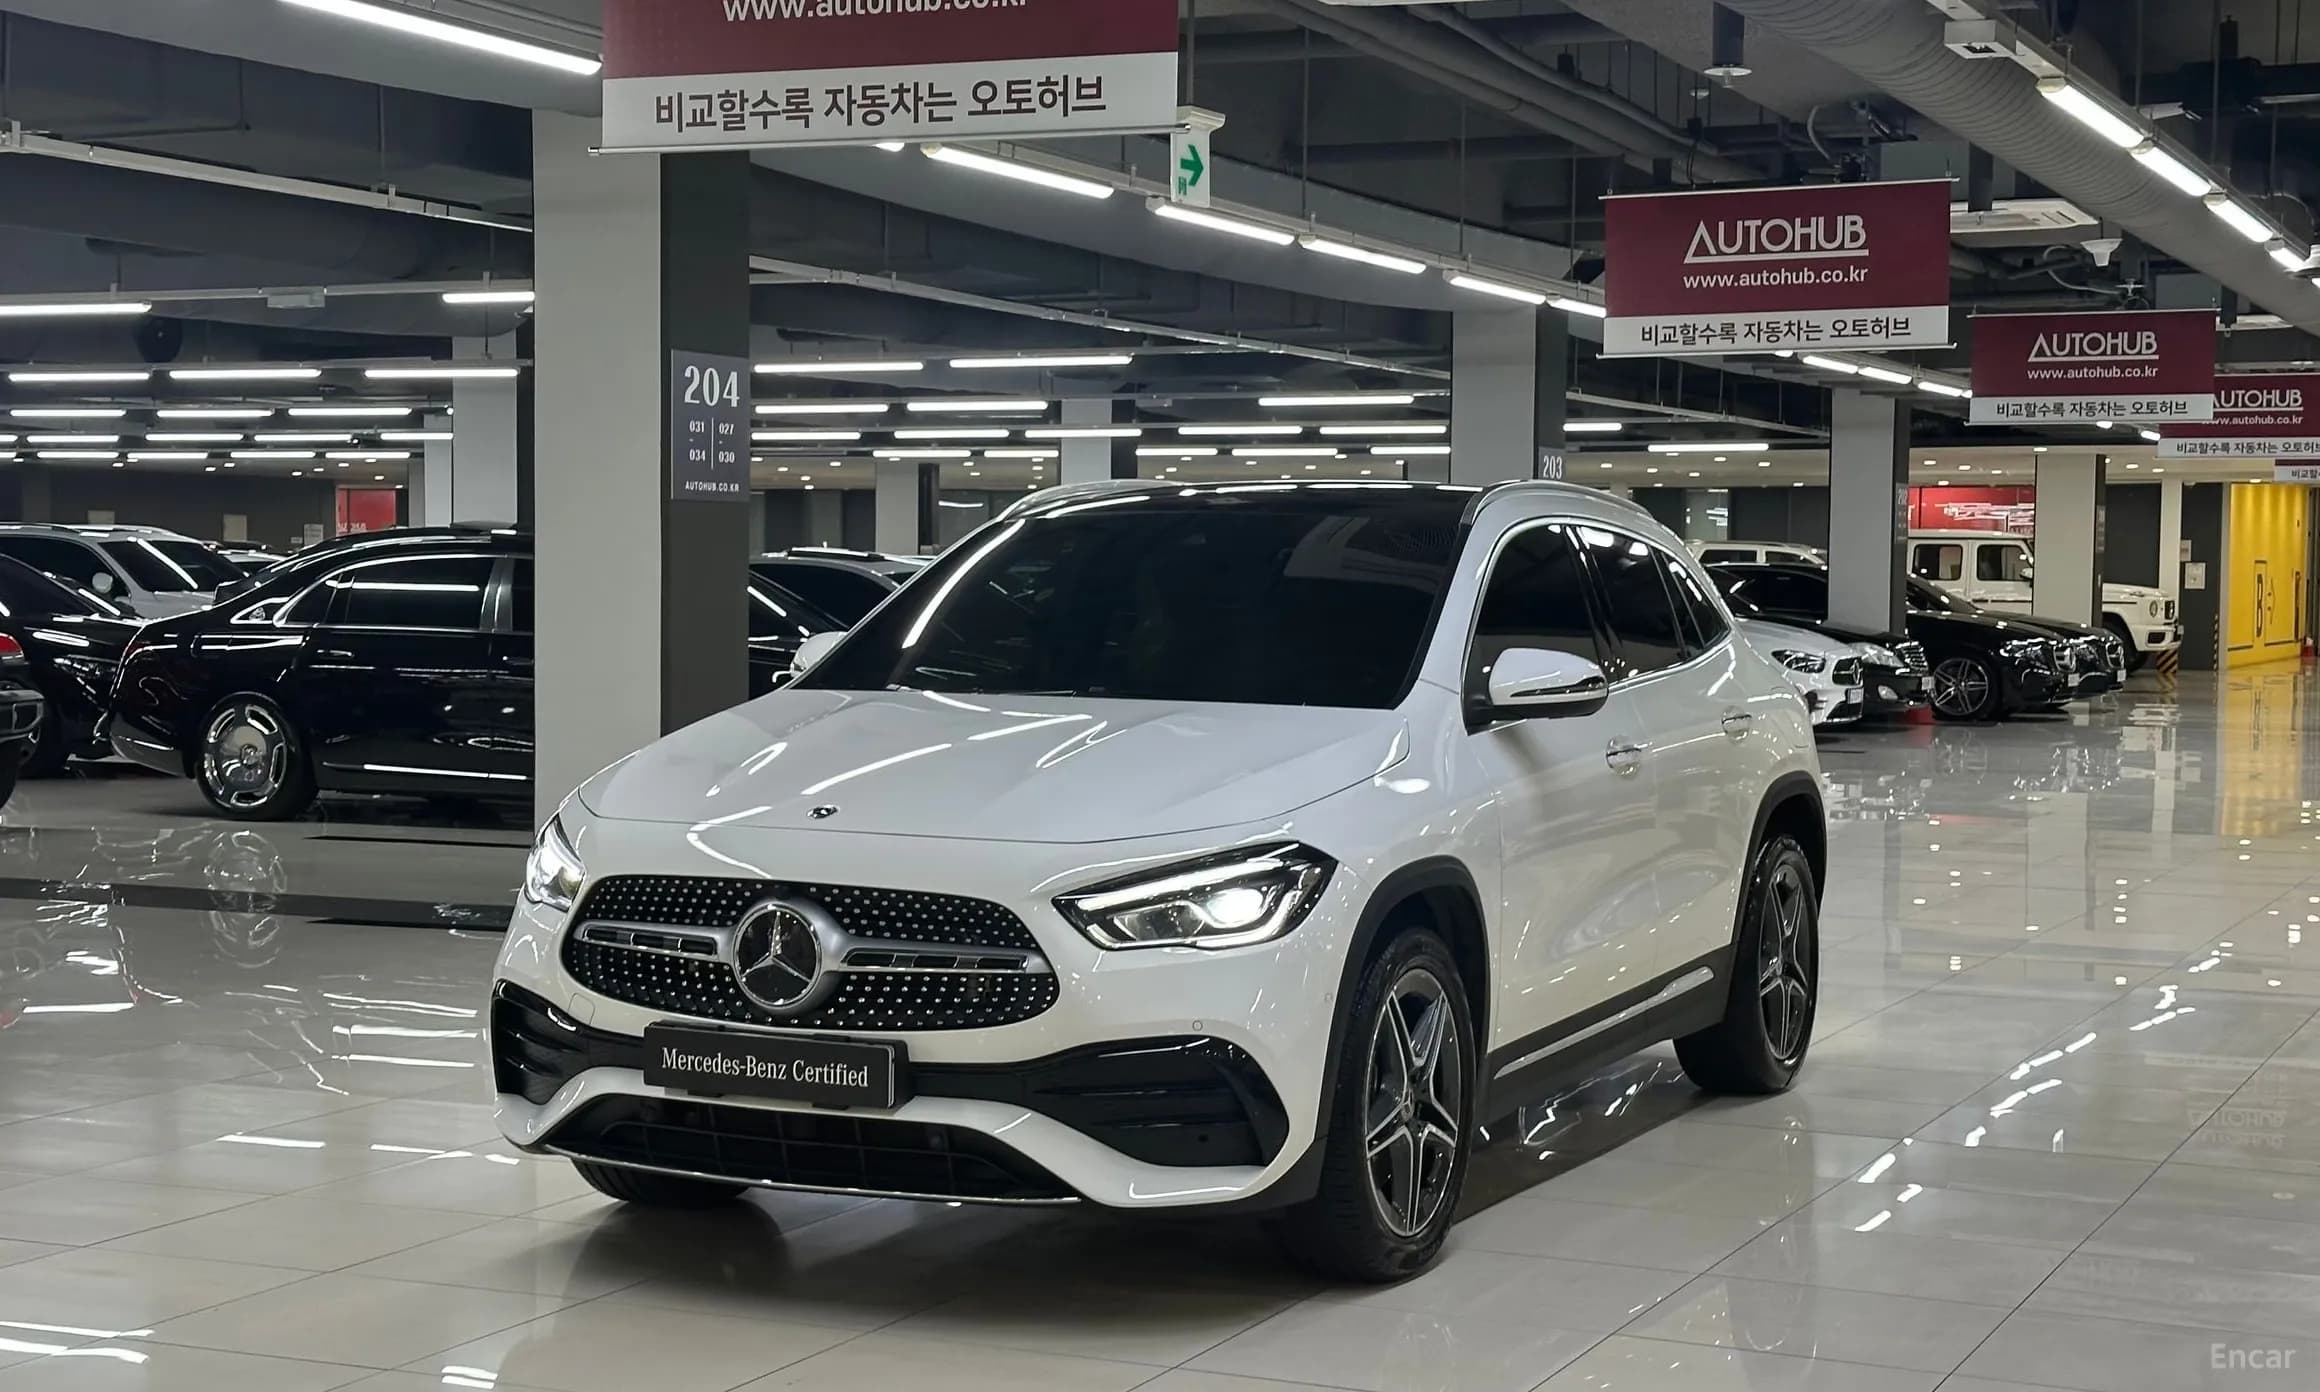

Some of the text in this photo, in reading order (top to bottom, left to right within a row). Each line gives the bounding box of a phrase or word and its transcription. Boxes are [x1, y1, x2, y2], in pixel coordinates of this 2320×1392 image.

[655, 75, 1107, 133] 비교할수록 자동차는 오토허브
[1684, 214, 1869, 264] AUTOHUB
[1683, 265, 1869, 289] www.autohub.co.kr
[1641, 317, 1912, 347] 비교할수록 자동차는 오토허브
[2028, 331, 2160, 363] AUTOHUB
[2027, 365, 2159, 380] www.autohub.co.kr
[684, 365, 740, 408] 204
[1997, 400, 2188, 418] 비교할수록 자동차는 오토허브
[689, 420, 705, 433] 031
[718, 422, 735, 435] 027
[689, 449, 706, 462] 034
[718, 451, 735, 463] 030
[1543, 455, 1562, 480] 203
[685, 480, 740, 493] AUTOHUB.CO.KR
[662, 1047, 869, 1087] Mercedes-Benz Certified
